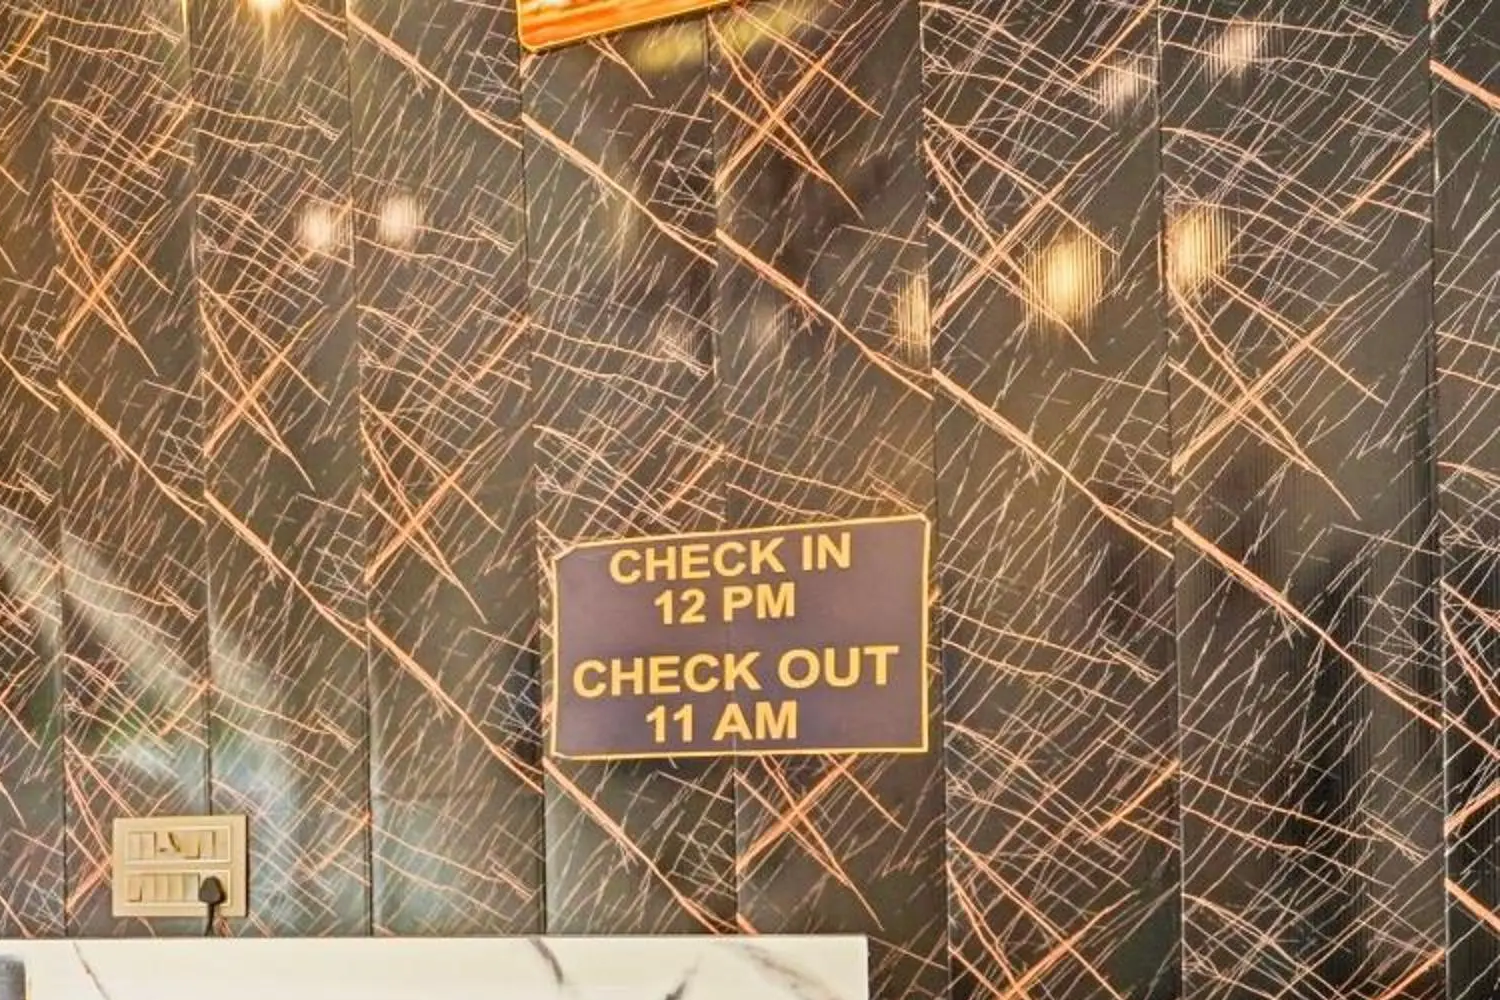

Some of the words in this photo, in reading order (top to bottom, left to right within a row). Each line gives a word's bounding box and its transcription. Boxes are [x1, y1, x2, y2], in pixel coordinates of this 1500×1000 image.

[609, 537, 785, 585] CHECK
[802, 532, 852, 571] IN
[654, 590, 706, 625] 12
[723, 582, 796, 621] PM
[573, 651, 761, 697] CHECK
[778, 645, 900, 688] OUT
[645, 704, 694, 743] 11
[712, 700, 798, 742] AM
